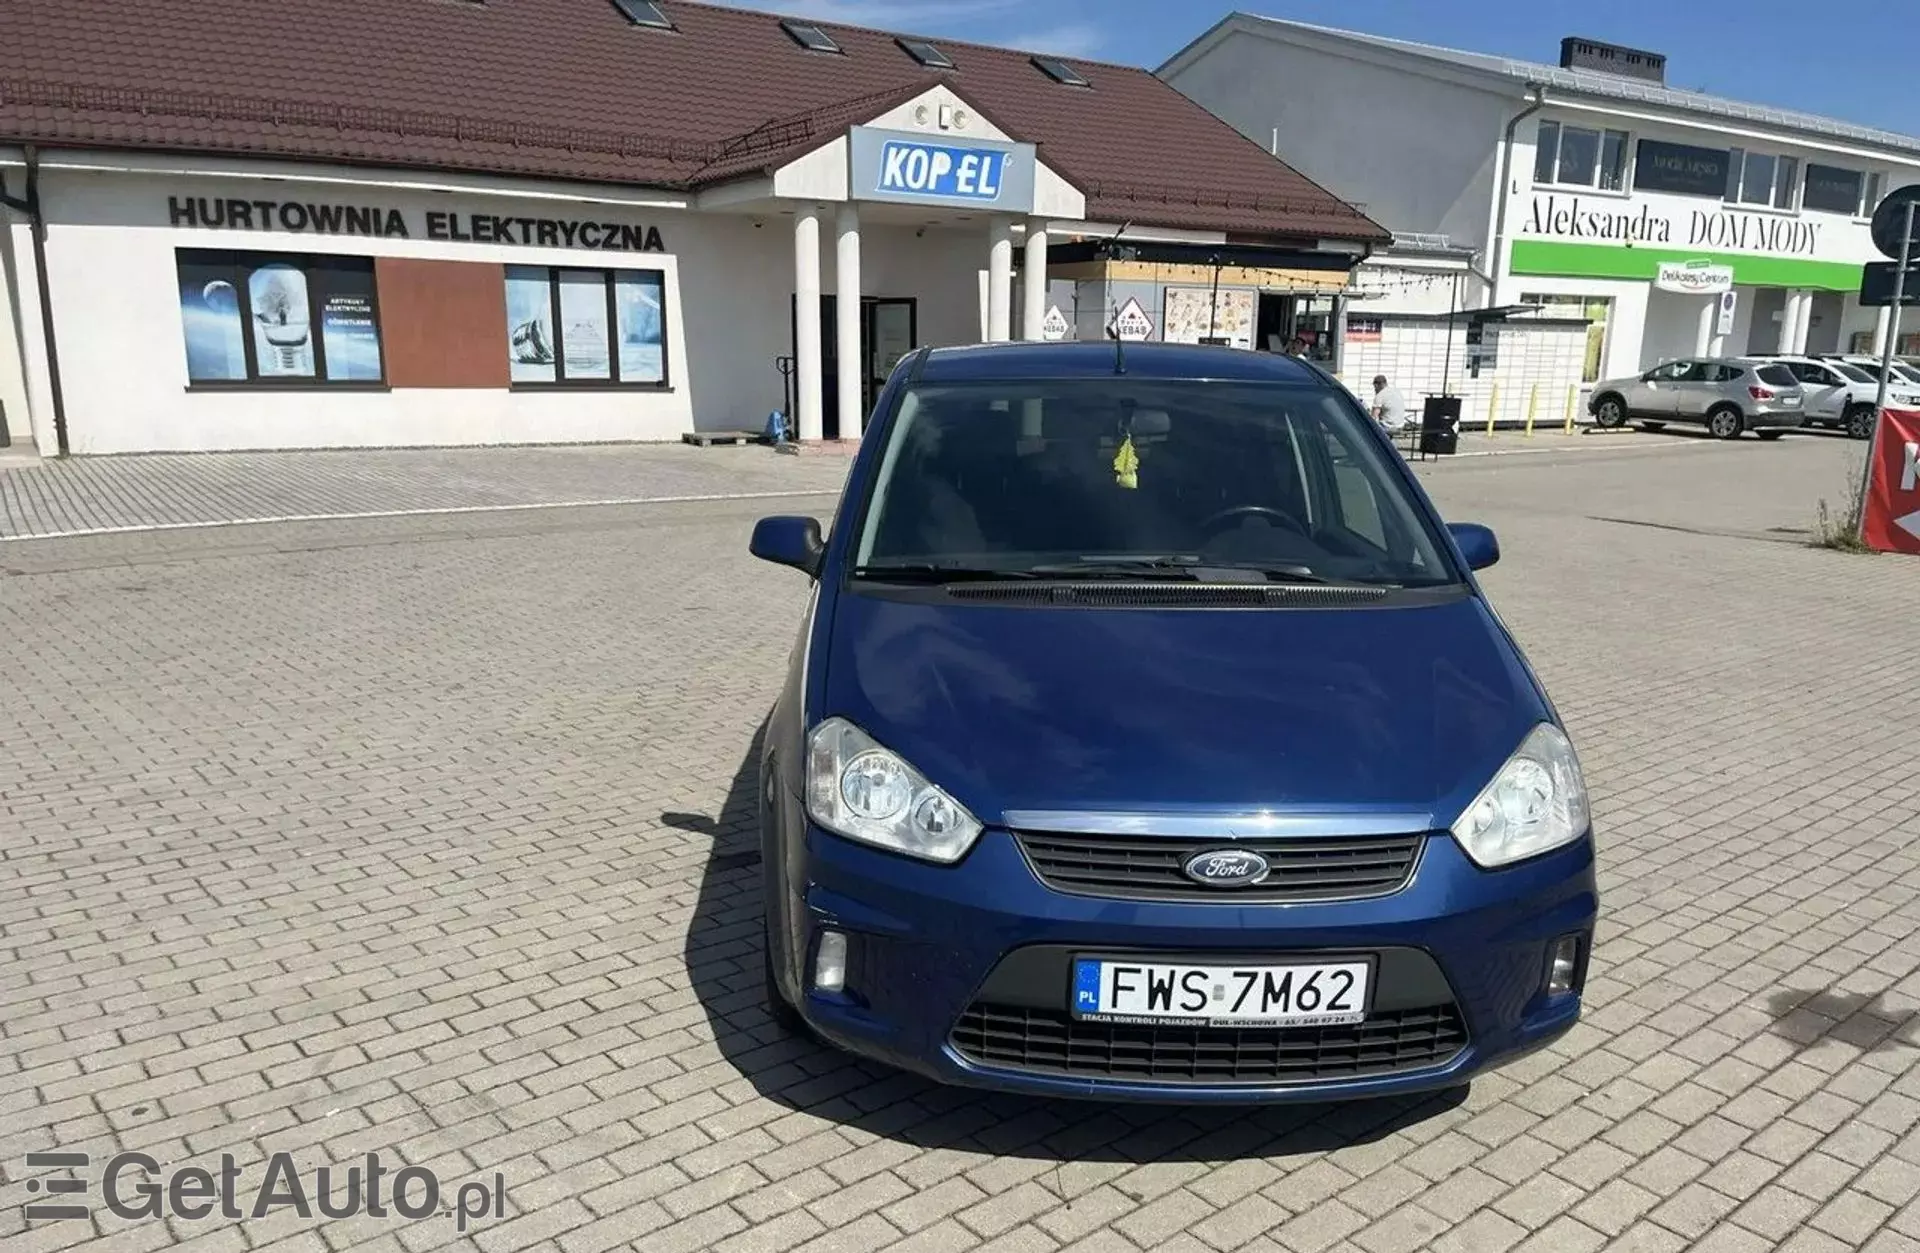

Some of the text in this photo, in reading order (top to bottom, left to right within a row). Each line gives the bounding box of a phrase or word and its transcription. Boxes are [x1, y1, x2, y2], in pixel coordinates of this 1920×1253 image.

[168, 196, 664, 252] HURTOWNIA ELEKTRYCZNA
[1522, 195, 1822, 254] Aleksandra DOM MODY
[1205, 857, 1249, 877] Ford
[1079, 991, 1097, 1003] PL
[1111, 967, 1355, 1013] FWS 7M62
